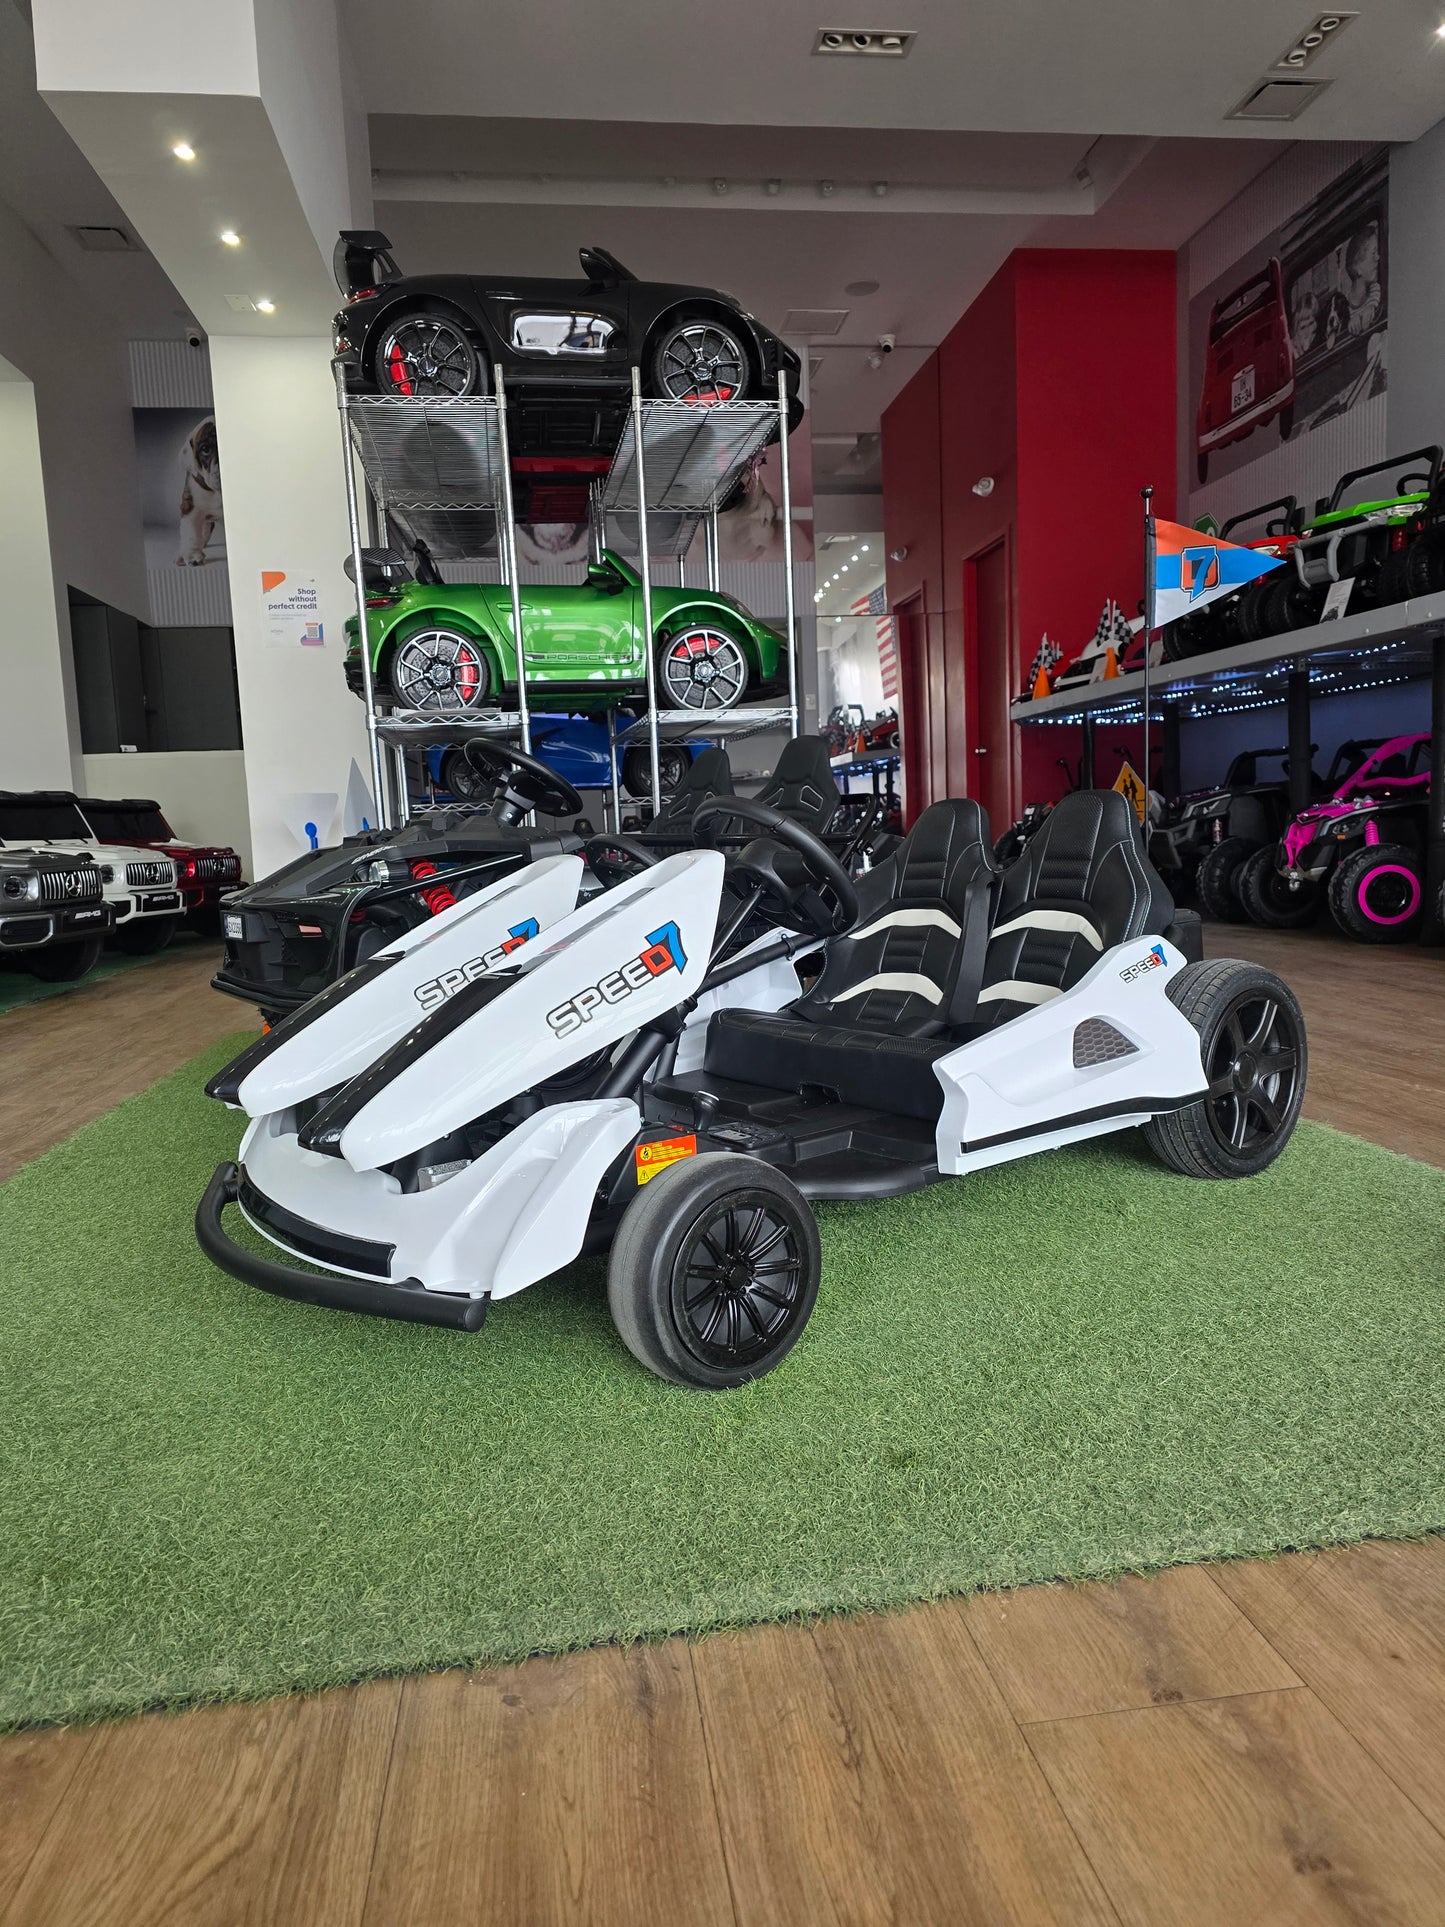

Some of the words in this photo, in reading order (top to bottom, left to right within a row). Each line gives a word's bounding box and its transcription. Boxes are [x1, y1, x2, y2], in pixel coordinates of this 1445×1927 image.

[297, 588, 317, 596] Shop
[268, 603, 295, 611] perfect
[76, 909, 102, 919] AMG
